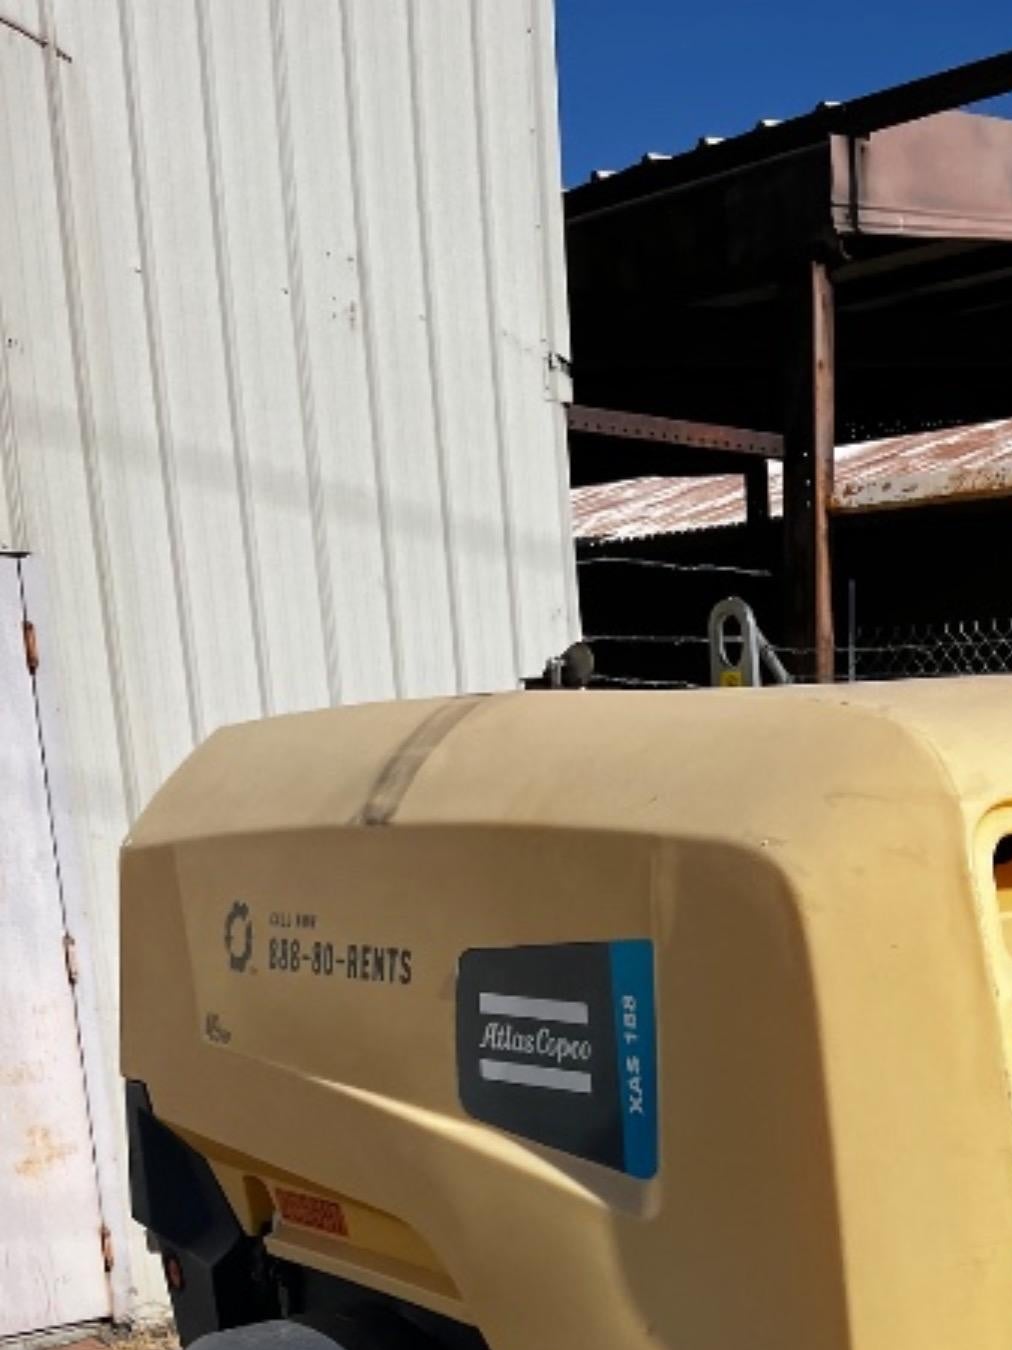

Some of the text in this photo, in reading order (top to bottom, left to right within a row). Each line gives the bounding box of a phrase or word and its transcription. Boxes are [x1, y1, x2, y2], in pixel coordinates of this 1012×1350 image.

[268, 938, 412, 985] 888-80-RENTS
[622, 996, 643, 1114] XAS 188
